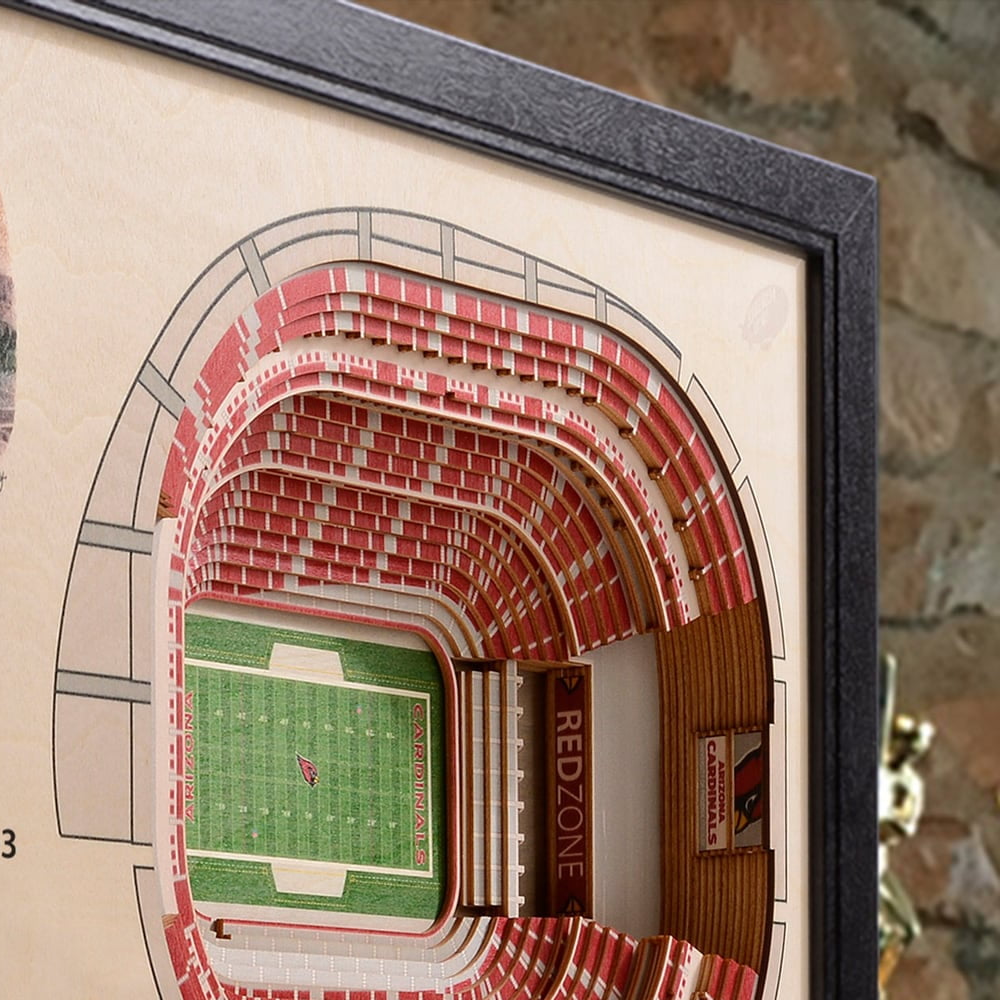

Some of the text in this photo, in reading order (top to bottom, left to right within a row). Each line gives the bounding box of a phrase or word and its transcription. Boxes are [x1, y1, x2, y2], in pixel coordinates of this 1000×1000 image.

[184, 691, 195, 824] ARIZONA
[412, 703, 427, 866] CARDINALS
[557, 709, 584, 880] REDZONE
[706, 740, 718, 846] CARDINALS
[717, 760, 726, 824] ARIZONA
